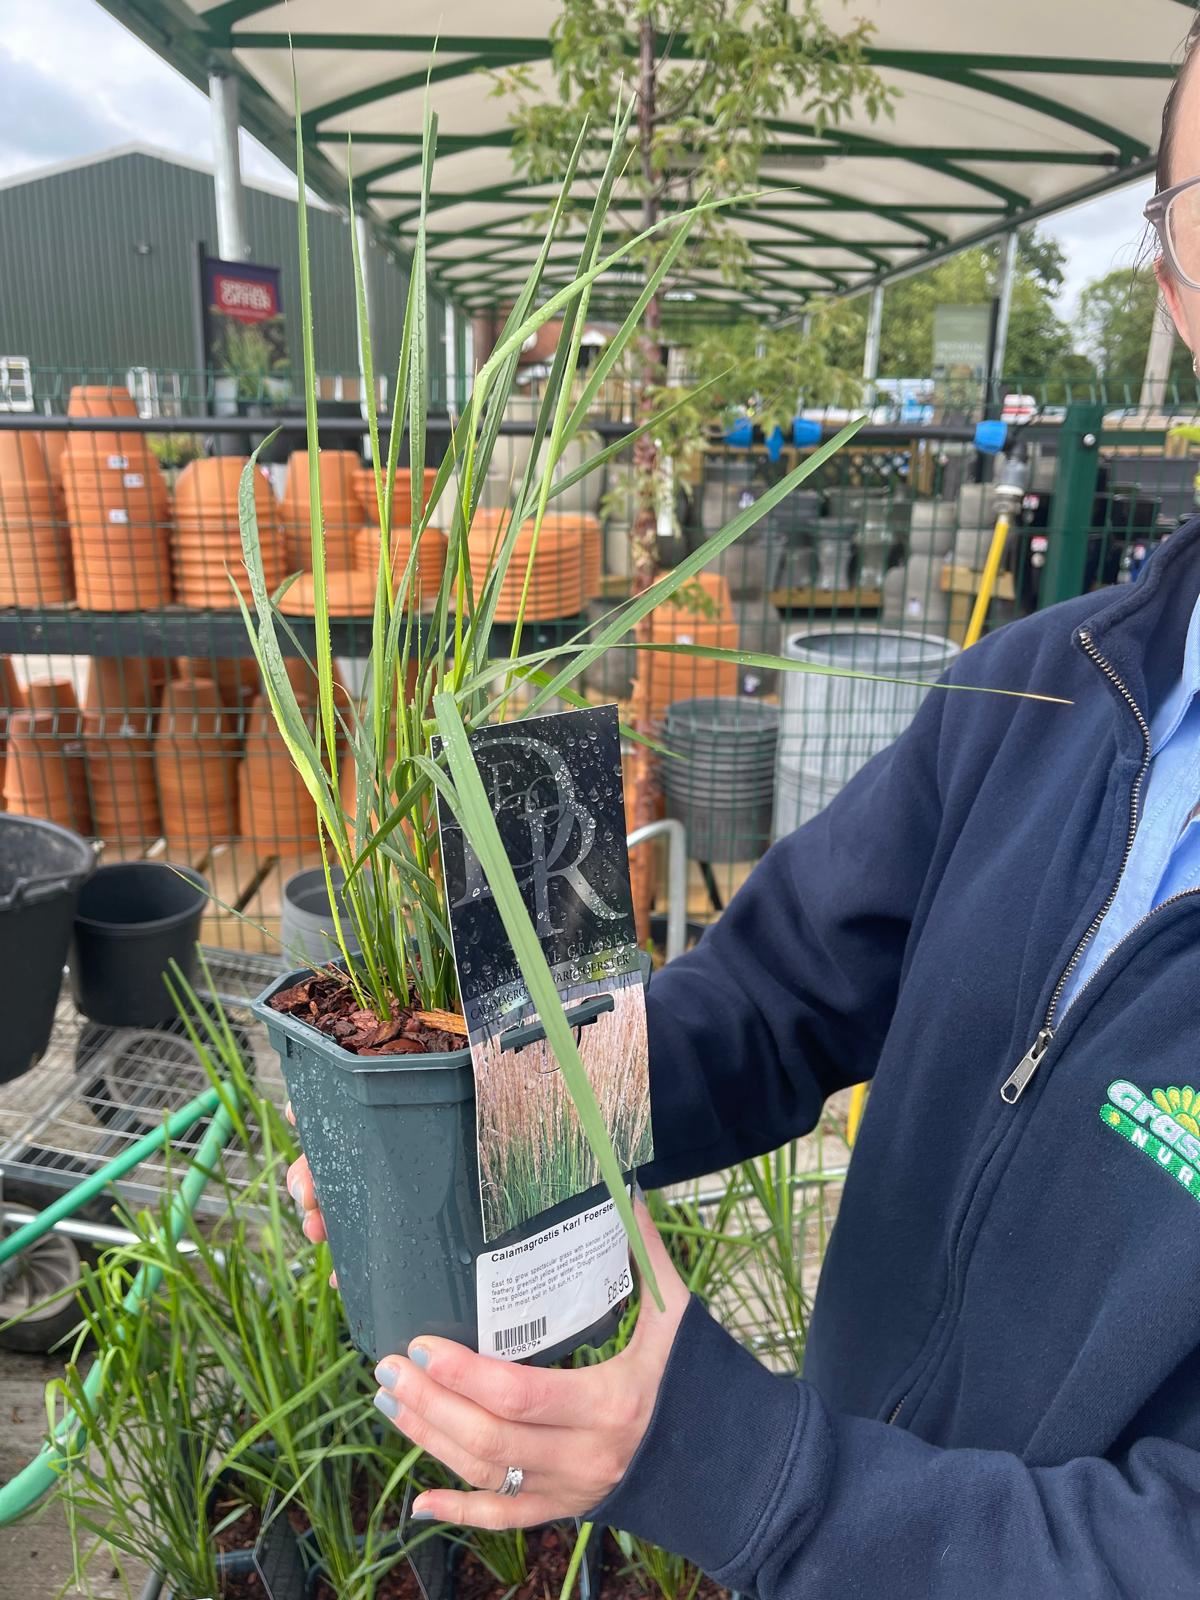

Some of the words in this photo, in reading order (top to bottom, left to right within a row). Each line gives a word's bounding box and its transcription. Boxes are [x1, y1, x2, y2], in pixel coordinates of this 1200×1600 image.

[568, 929, 630, 958] GRASSES
[491, 1229, 560, 1262] Calamagrostis
[563, 1218, 581, 1233] Karl
[491, 1286, 515, 1296] feathery
[516, 1275, 538, 1290] greenish
[540, 1267, 555, 1280] yellow
[556, 1259, 568, 1270] seed
[491, 1296, 508, 1304] Turns
[510, 1289, 529, 1302] golden
[531, 1282, 546, 1294] yellow
[547, 1274, 558, 1284] over
[576, 1255, 595, 1269] Drought
[515, 1272, 529, 1283] grow
[530, 1257, 557, 1275] spectacular
[559, 1250, 573, 1262] grass
[574, 1244, 584, 1253] with
[491, 1305, 505, 1313] best
[532, 1291, 541, 1301] soil
[548, 1284, 556, 1293] full
[608, 1268, 629, 1304] £8.95
